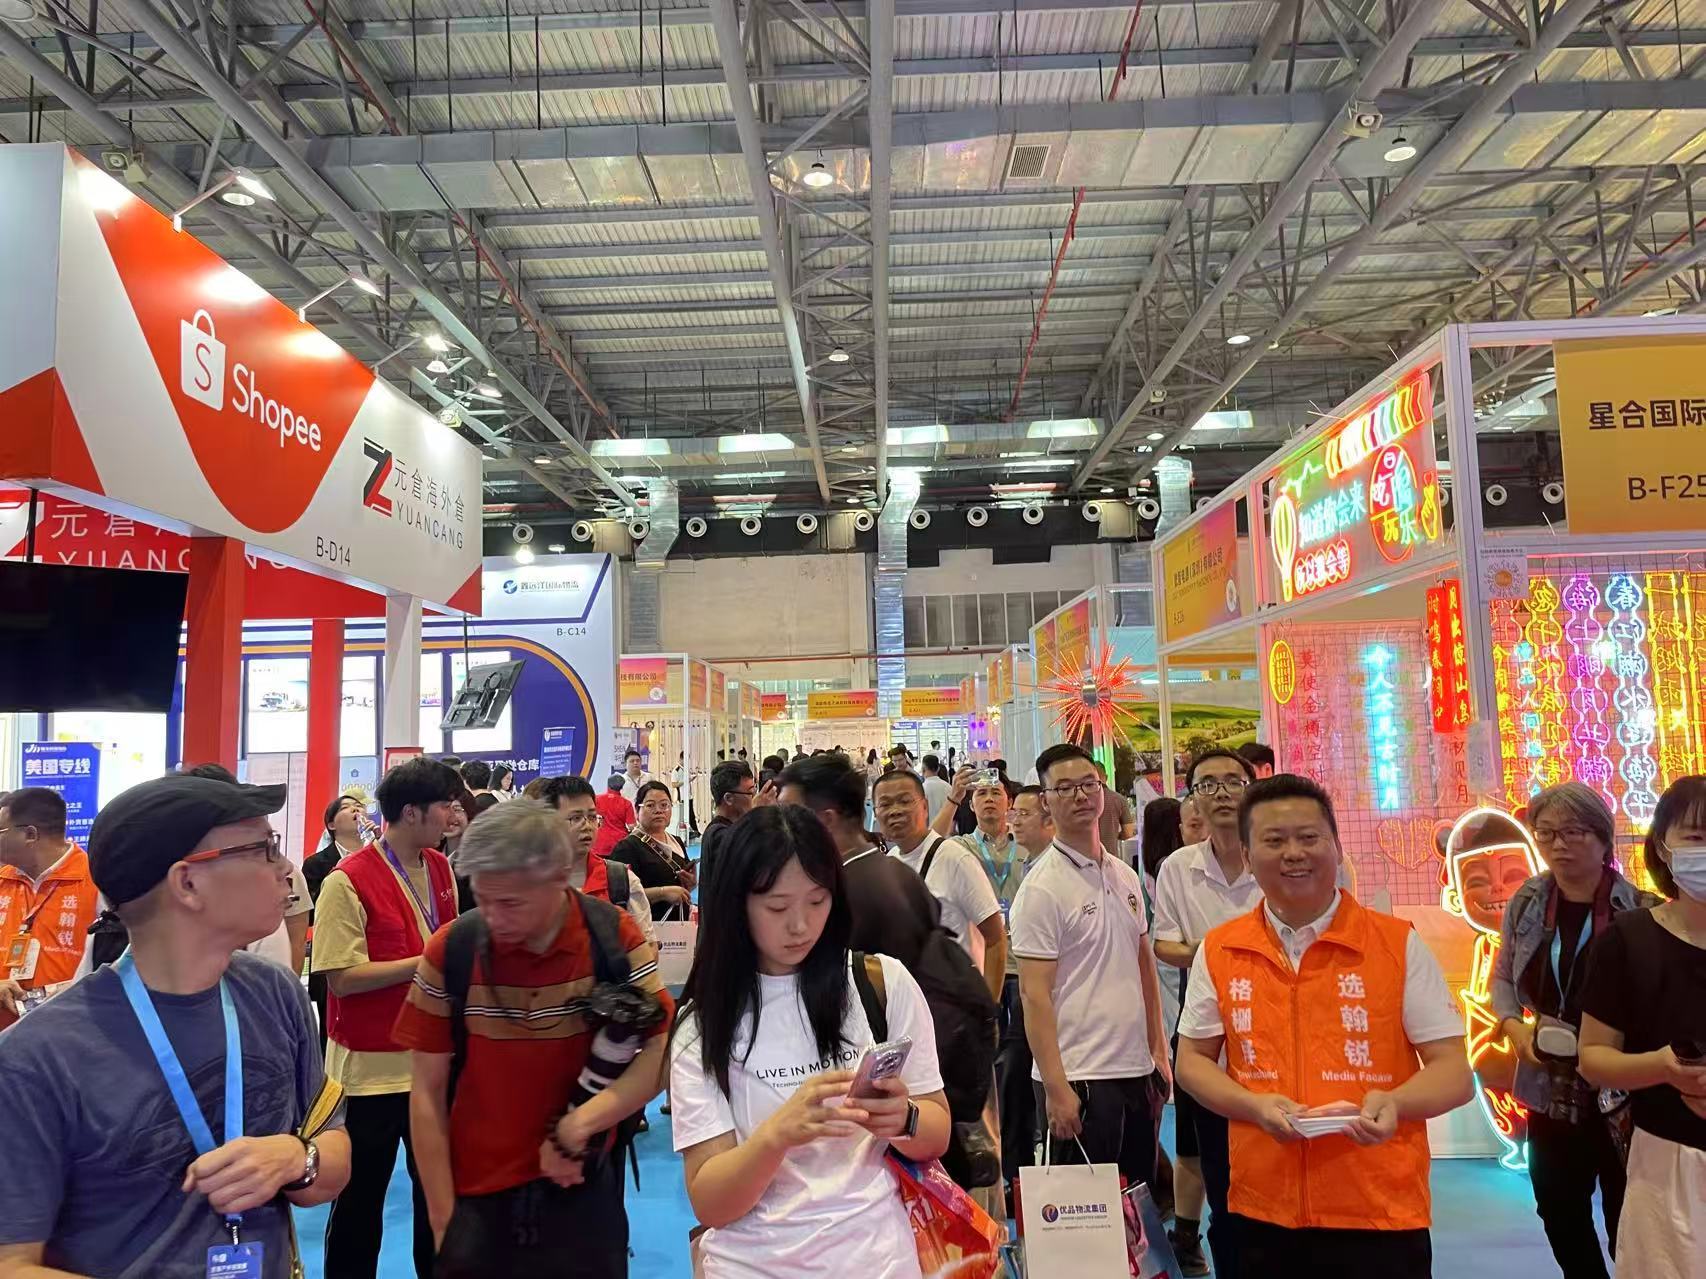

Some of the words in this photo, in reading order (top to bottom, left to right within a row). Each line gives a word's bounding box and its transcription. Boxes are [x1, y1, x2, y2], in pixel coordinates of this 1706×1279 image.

[232, 362, 322, 452] Shopee
[1589, 399, 1706, 430] 星合国际
[1628, 474, 1706, 500] B-F25
[396, 500, 463, 550] YUANCANG
[316, 536, 351, 567] B-D14
[556, 628, 587, 636] B-C14
[1449, 586, 1470, 724] 月出惊山鸟
[25, 758, 91, 775] 美国专线
[1337, 972, 1374, 1068] 选翰锐
[756, 1067, 788, 1080] LIVE
[791, 1064, 806, 1077] IN
[1321, 1071, 1356, 1082] Media
[1060, 1202, 1107, 1215] 优品物流集团
